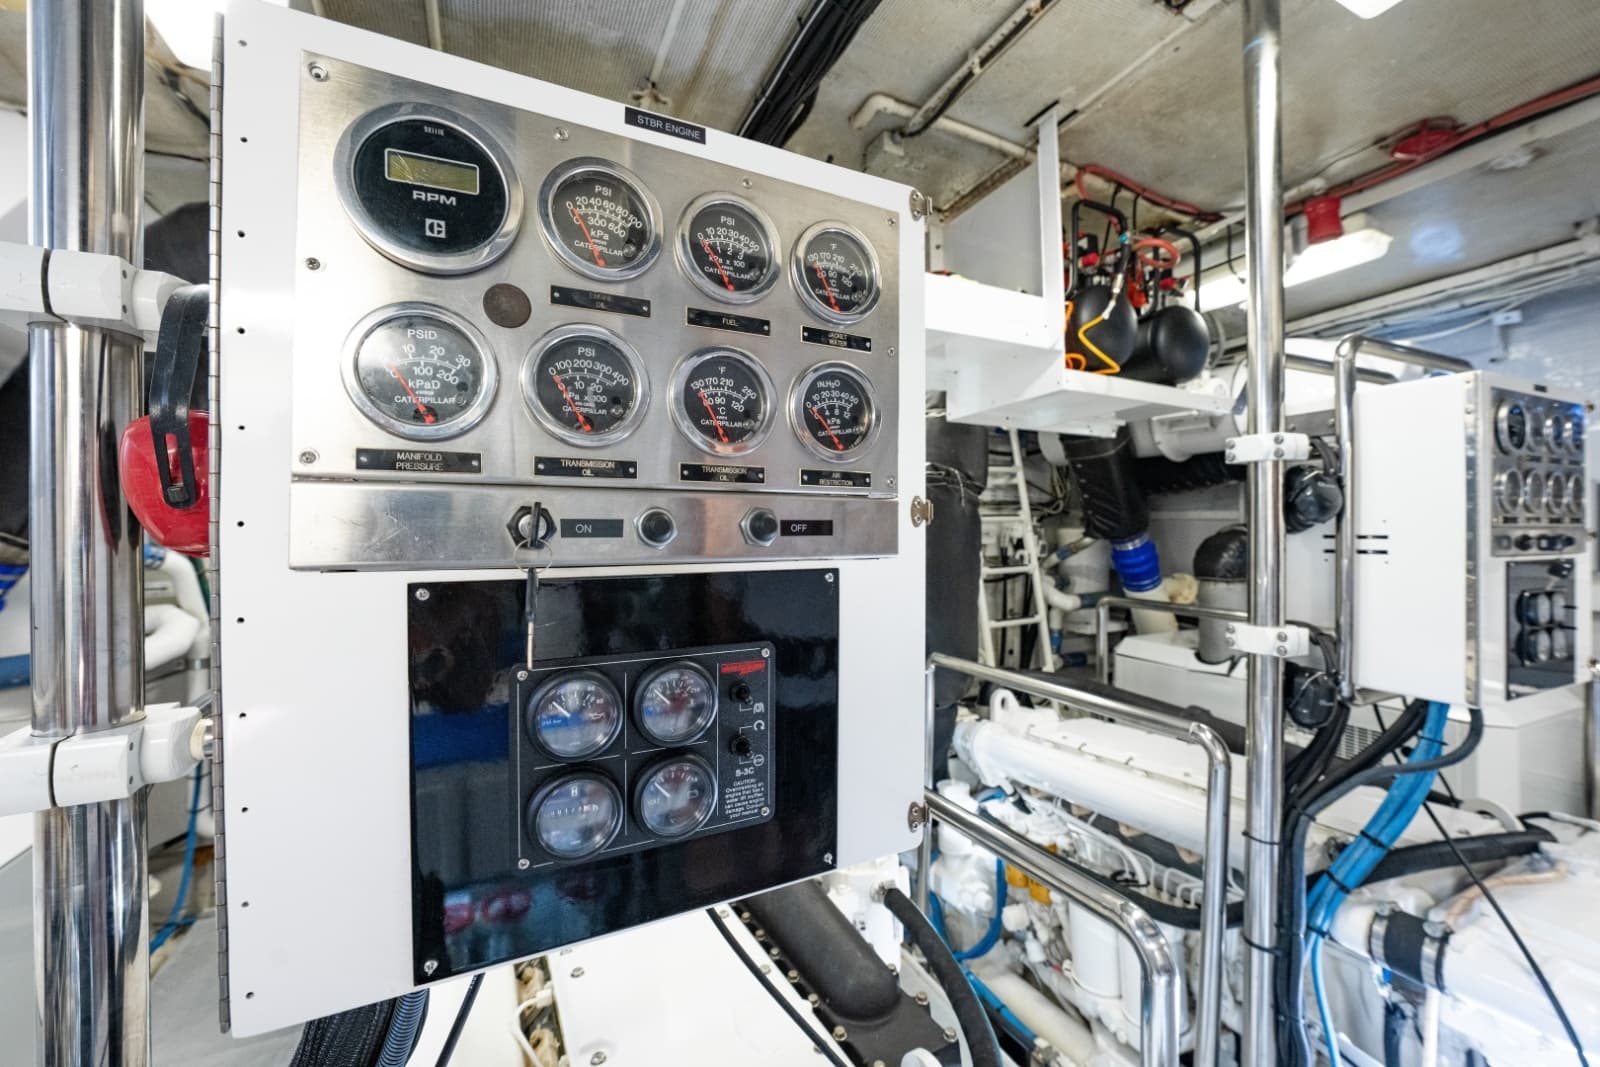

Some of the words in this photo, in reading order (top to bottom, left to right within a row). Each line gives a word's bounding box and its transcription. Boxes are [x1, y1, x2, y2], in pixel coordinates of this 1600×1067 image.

[637, 114, 663, 129] STBR
[665, 122, 701, 140] ENGINE
[595, 185, 612, 197] PSI
[412, 190, 456, 206] RPM
[576, 196, 588, 205] 20
[589, 197, 602, 206] 40
[602, 200, 615, 210] 60
[615, 206, 629, 217] 80
[628, 213, 642, 228] 100
[720, 215, 735, 226] PSI
[587, 216, 607, 227] 300
[608, 222, 626, 238] 600
[705, 227, 715, 235] 10
[717, 227, 728, 235] 20
[728, 229, 739, 238] 30
[590, 228, 609, 240] kPa
[722, 317, 738, 327] FUEL
[407, 329, 437, 340] PSID
[401, 344, 416, 353] 10
[429, 345, 445, 356] 20
[456, 354, 471, 367] 30
[578, 347, 595, 357] PSI
[412, 366, 433, 376] 100
[436, 369, 459, 385] 200
[555, 360, 572, 370] 100
[573, 359, 593, 368] 200
[593, 362, 612, 374] 300
[612, 371, 629, 386] 400
[408, 379, 441, 389] kPaD
[574, 381, 585, 389] 10
[590, 382, 603, 393] 20
[690, 380, 705, 390] 130
[705, 377, 718, 385] 170
[720, 378, 734, 387] 210
[821, 390, 830, 398] 20
[714, 397, 726, 405] 90
[396, 451, 442, 461] MANIFOLD
[395, 461, 443, 471] PRESSURE
[560, 459, 615, 469] TRANSMISSION
[702, 465, 747, 475] TRANSMISSION
[576, 523, 592, 533] ON
[790, 523, 808, 533] OFF
